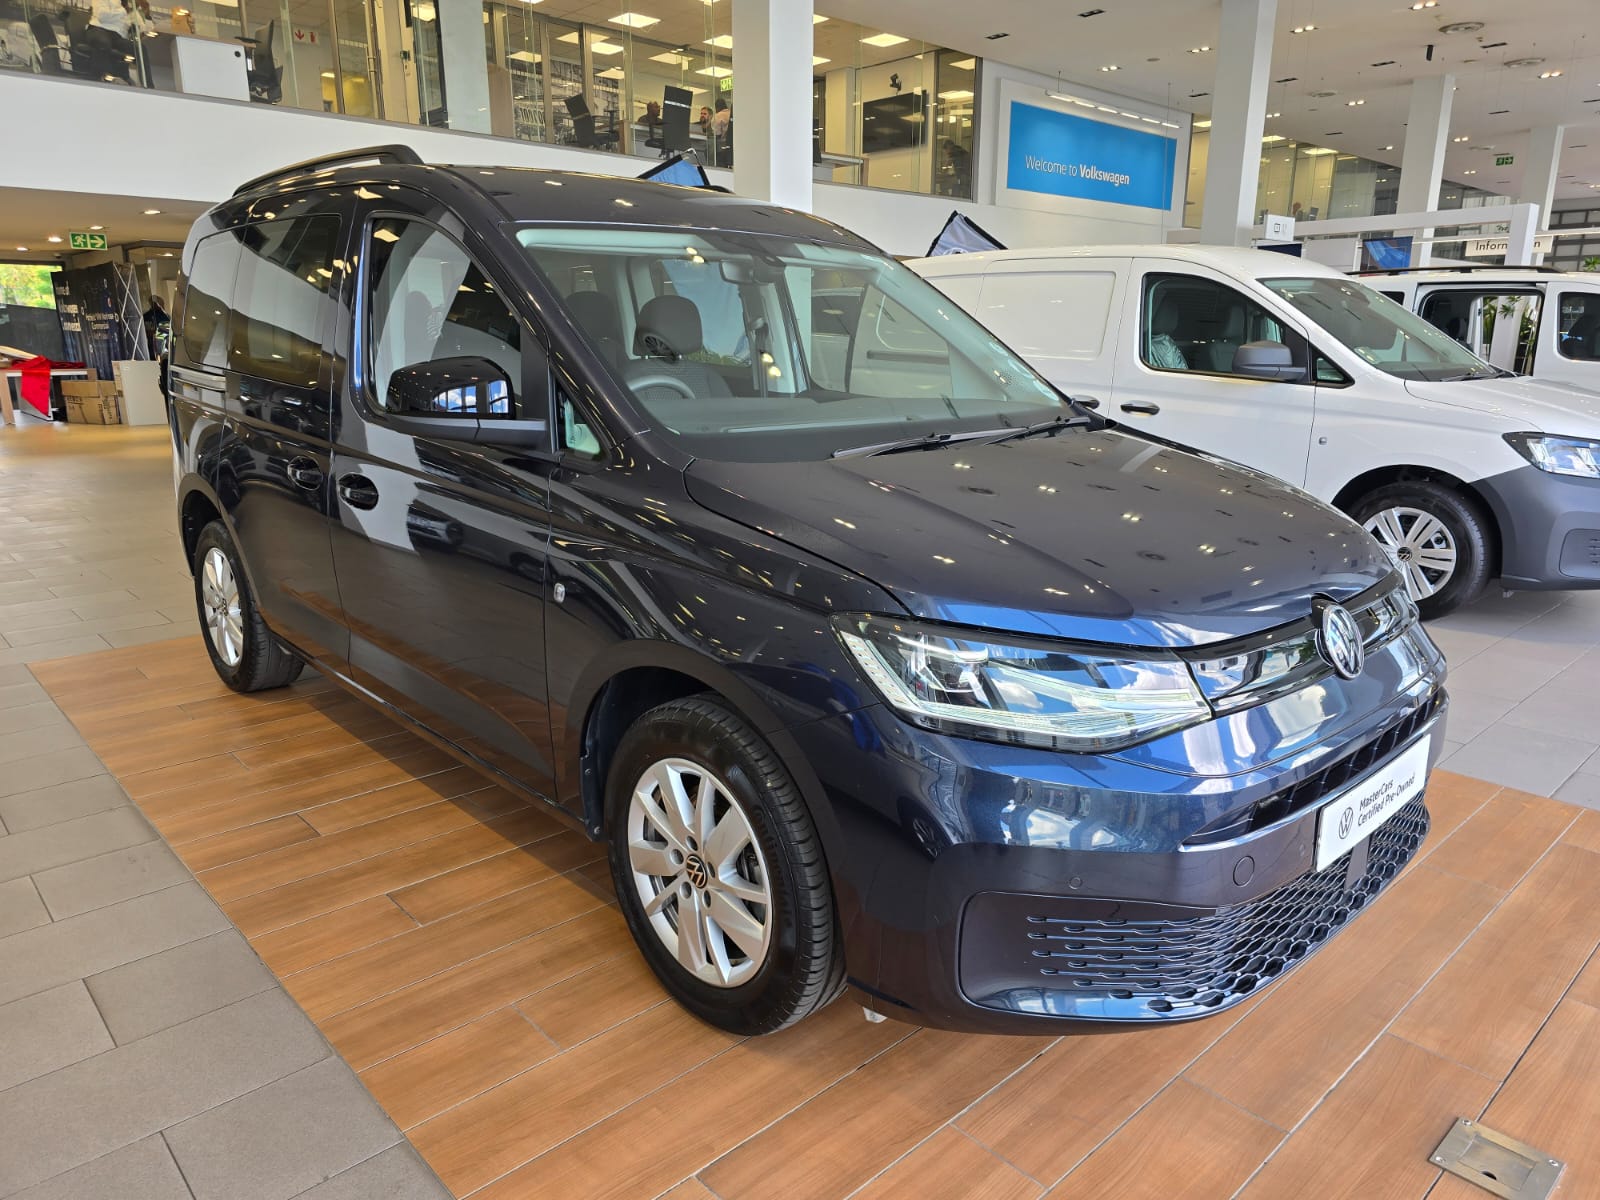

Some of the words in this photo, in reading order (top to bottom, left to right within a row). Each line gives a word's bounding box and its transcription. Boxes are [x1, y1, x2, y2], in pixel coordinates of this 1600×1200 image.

[1025, 154, 1067, 175] Welcome
[1069, 165, 1078, 176] to
[1079, 164, 1130, 186] Volkswagen
[1357, 799, 1384, 827] Certified
[1384, 771, 1416, 806] Pre-Owned
[1359, 779, 1394, 810] MasterCars
